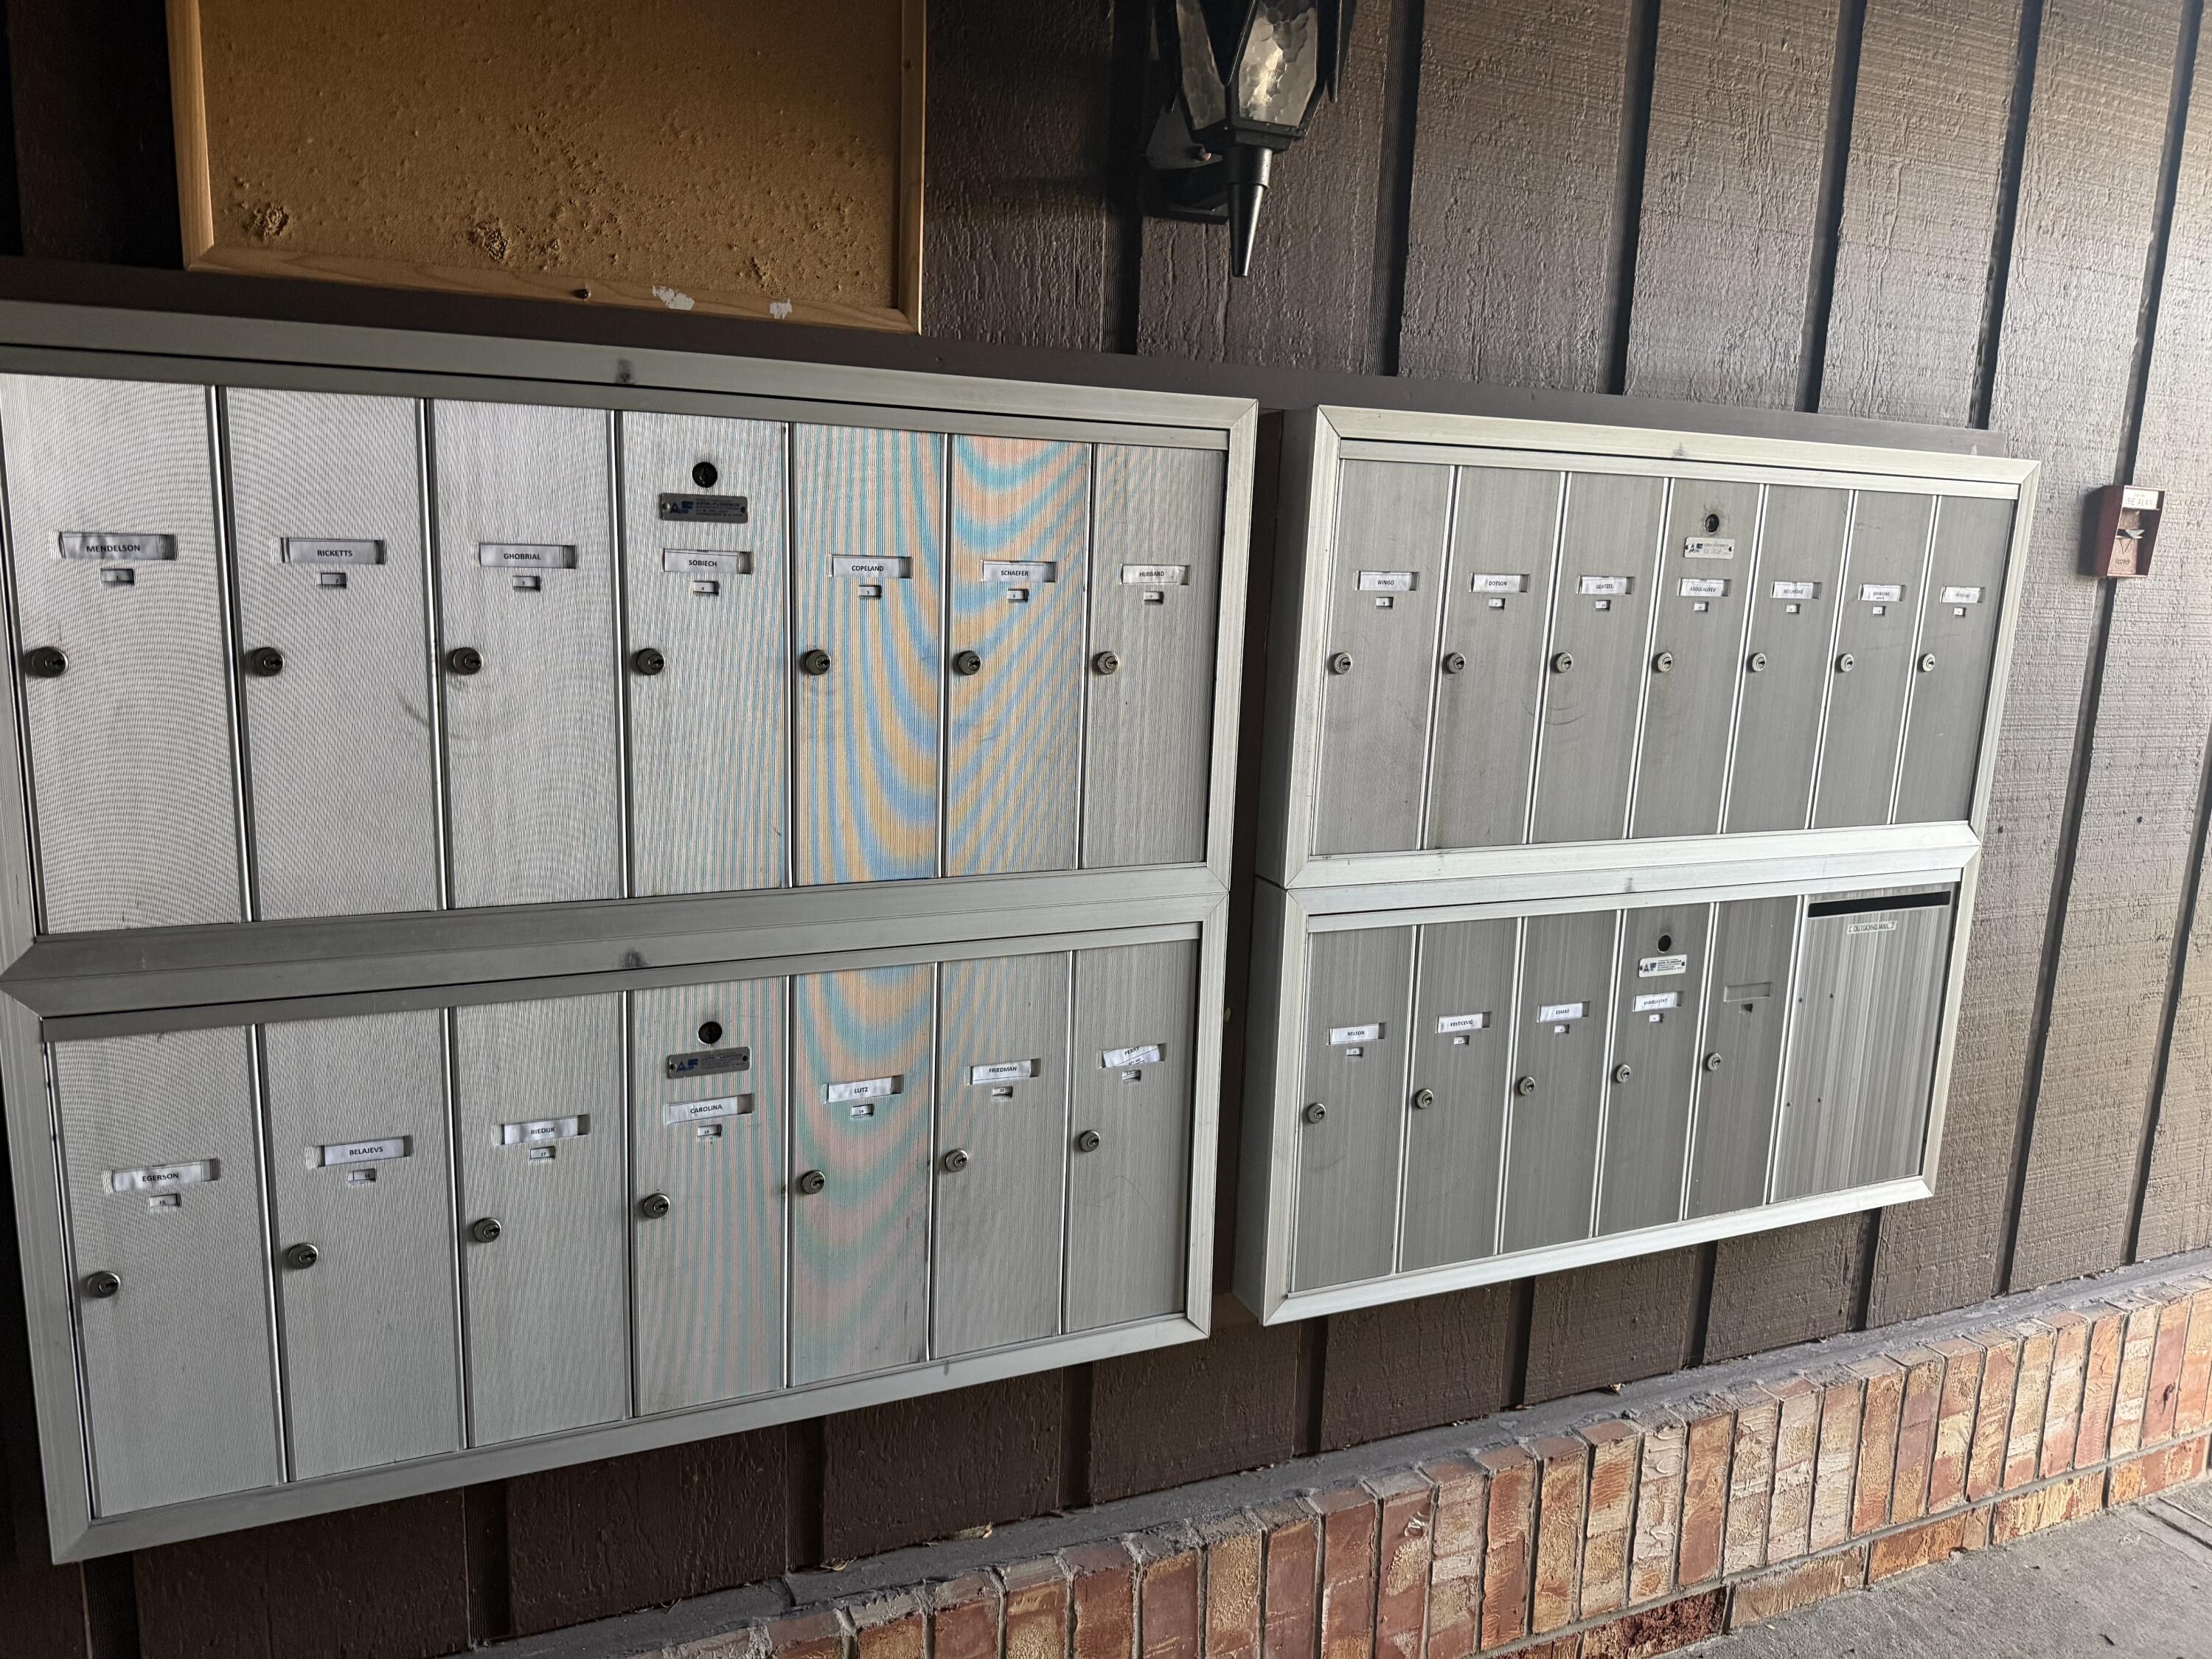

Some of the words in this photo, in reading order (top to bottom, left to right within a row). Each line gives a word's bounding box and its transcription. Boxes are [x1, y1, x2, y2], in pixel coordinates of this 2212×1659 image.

[86, 544, 141, 553] MENDELSON
[1124, 1046, 1139, 1056] PERRY
[690, 1104, 723, 1114] CAROLINA
[349, 1147, 383, 1155] BELAJEVS
[142, 1173, 179, 1182] EGERSON
